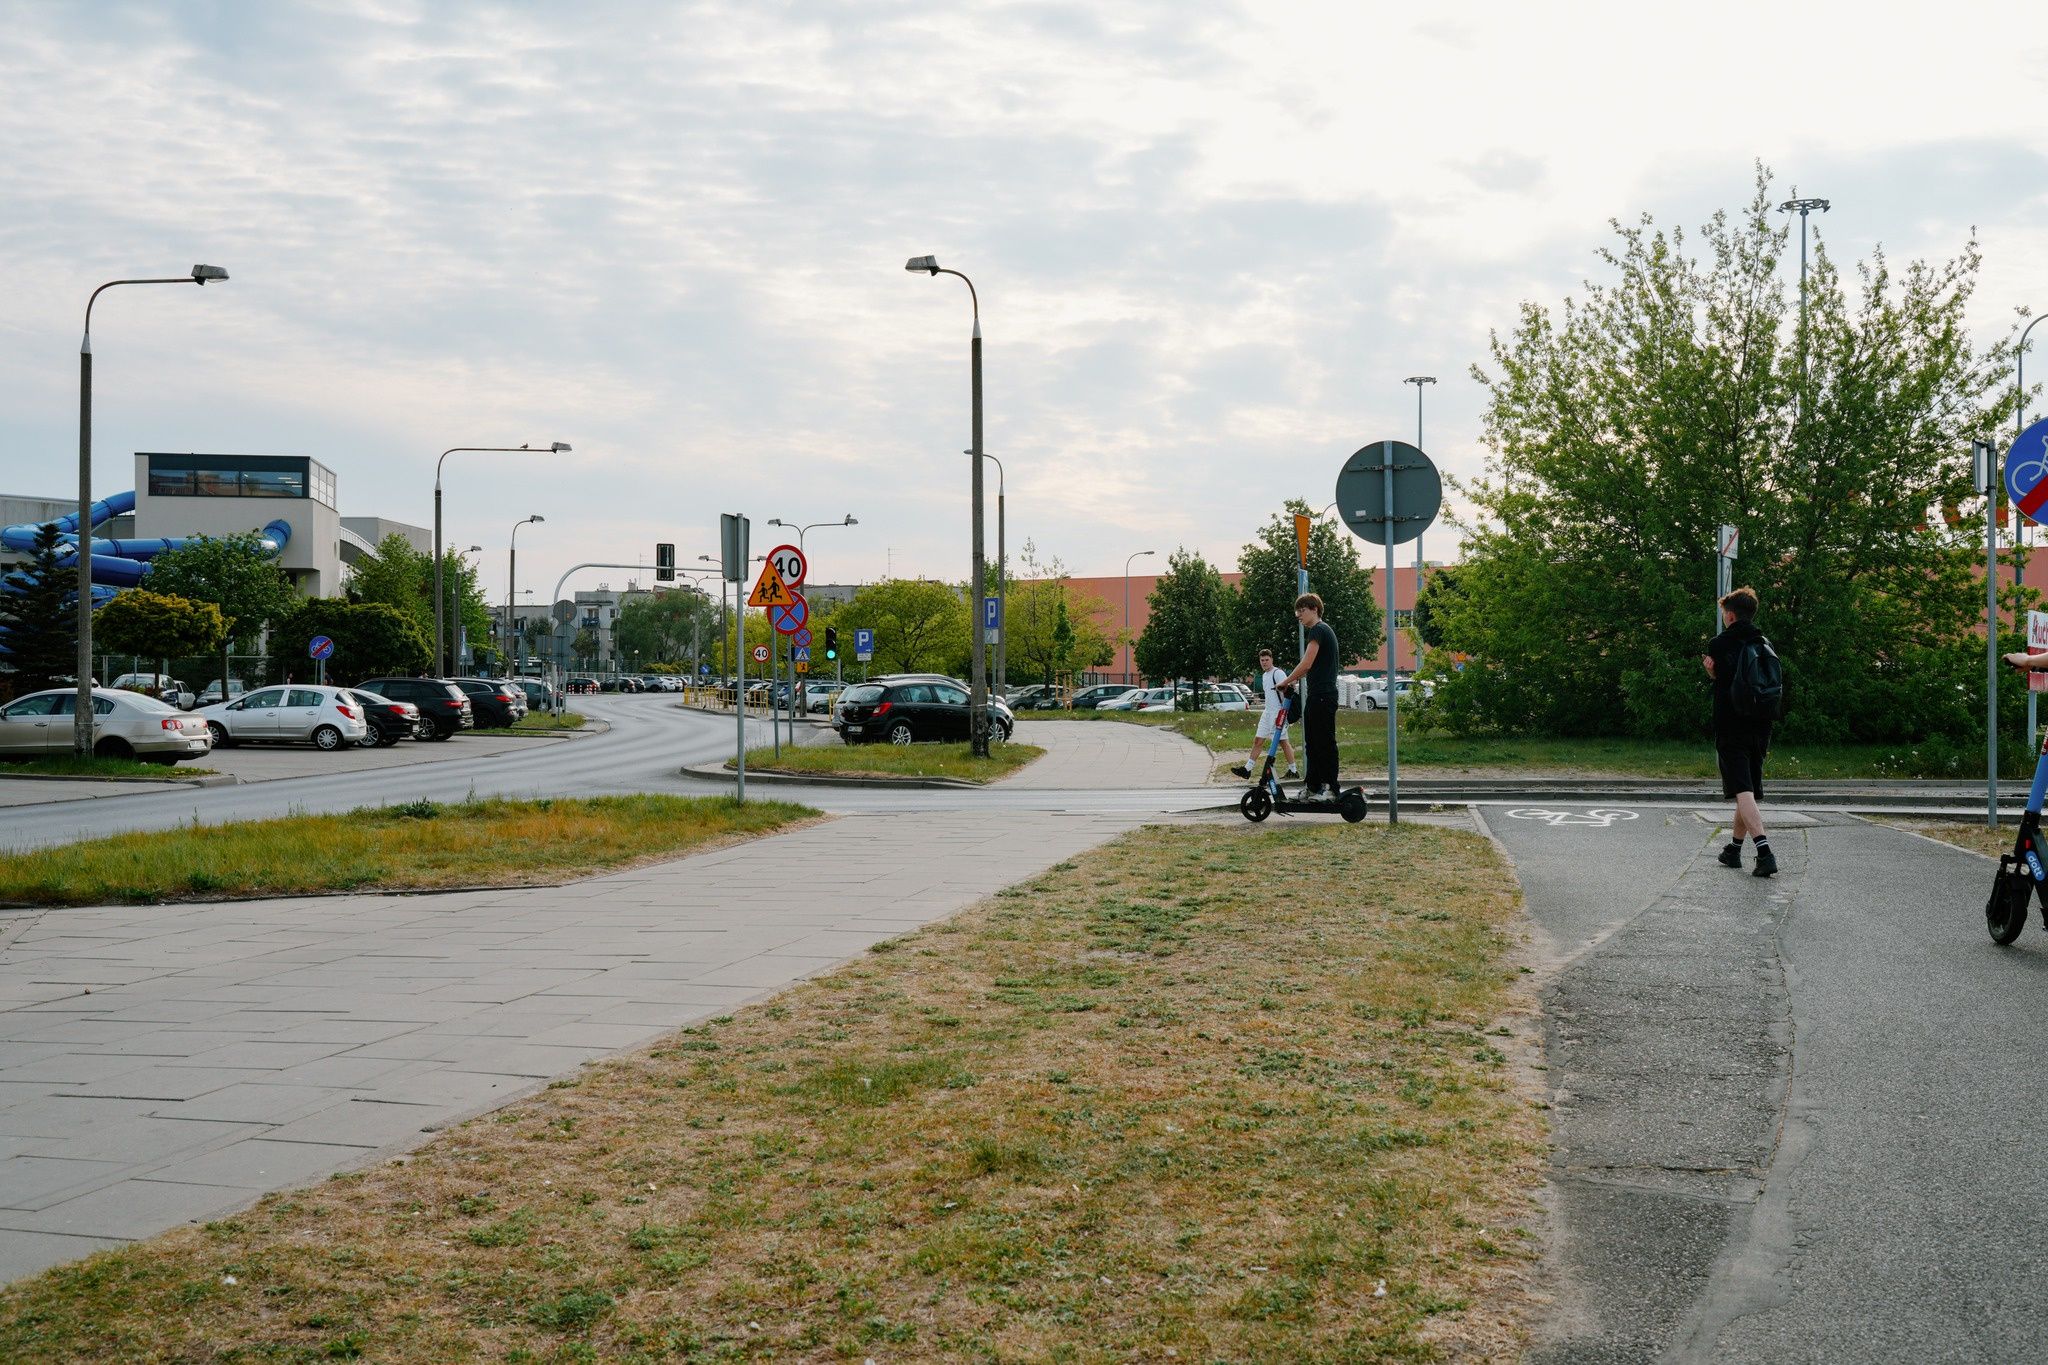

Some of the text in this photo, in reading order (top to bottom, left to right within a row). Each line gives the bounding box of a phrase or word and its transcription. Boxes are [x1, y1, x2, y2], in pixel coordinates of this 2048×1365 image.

[775, 557, 801, 577] 40
[988, 601, 996, 625] P
[859, 631, 870, 646] P
[755, 650, 768, 658] 40
[2028, 855, 2042, 877] dott
